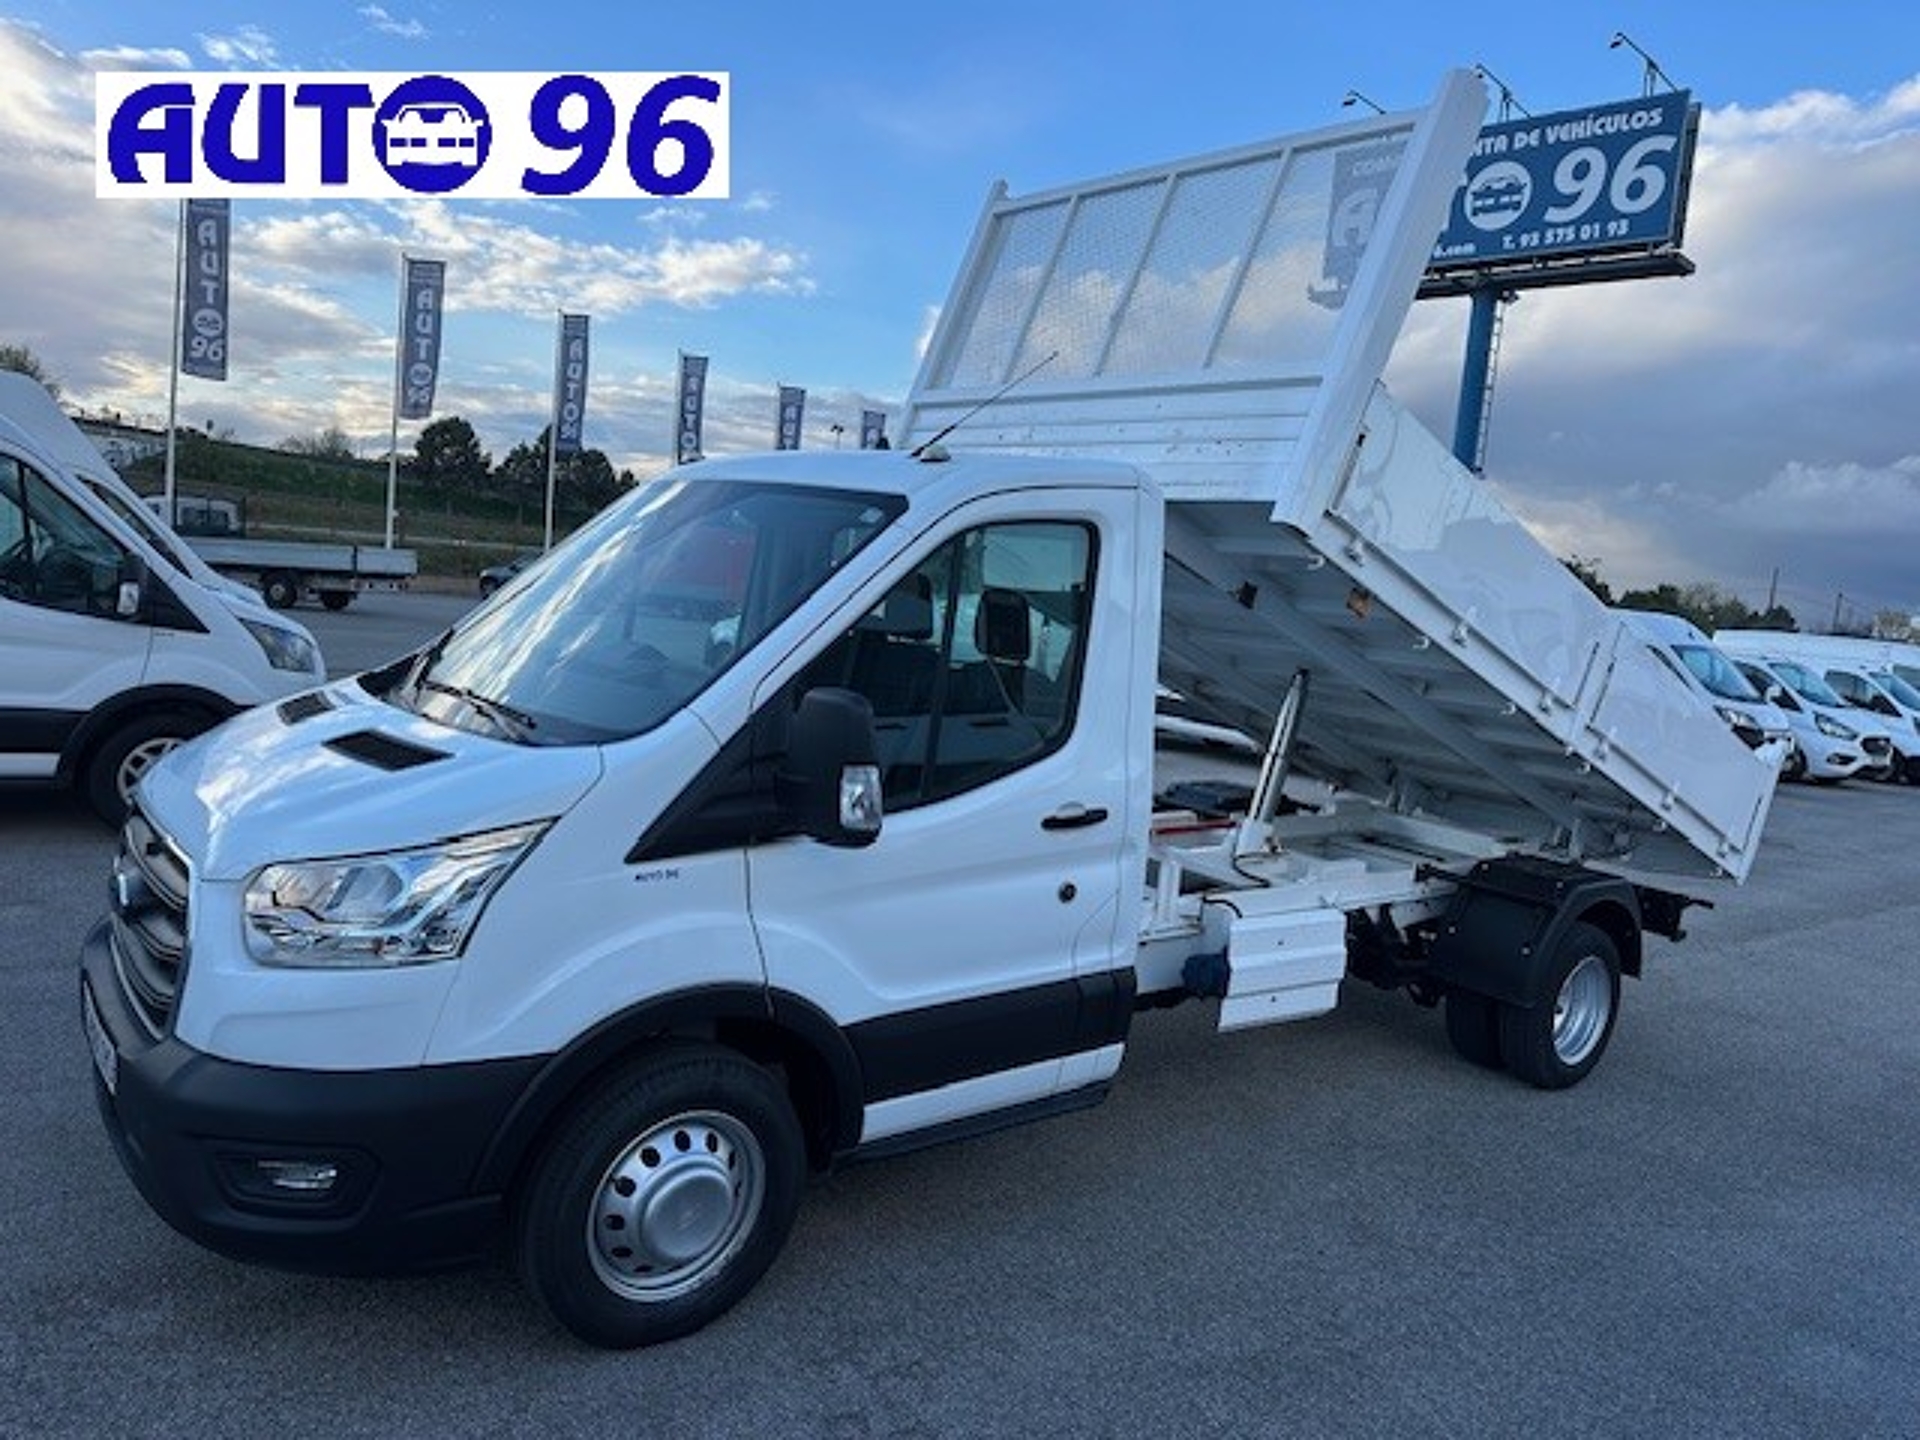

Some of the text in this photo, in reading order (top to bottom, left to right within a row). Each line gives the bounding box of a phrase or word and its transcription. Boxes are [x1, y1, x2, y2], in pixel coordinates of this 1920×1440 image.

[1514, 129, 1539, 149] DE
[1546, 107, 1663, 145] VEHÍCULOS
[1544, 134, 1678, 223] 96
[1502, 219, 1630, 249] T. 93 575 01 93
[192, 219, 223, 337] AUTO
[190, 335, 223, 361] 96
[410, 290, 432, 385] AUTO
[563, 340, 583, 420] AUTO
